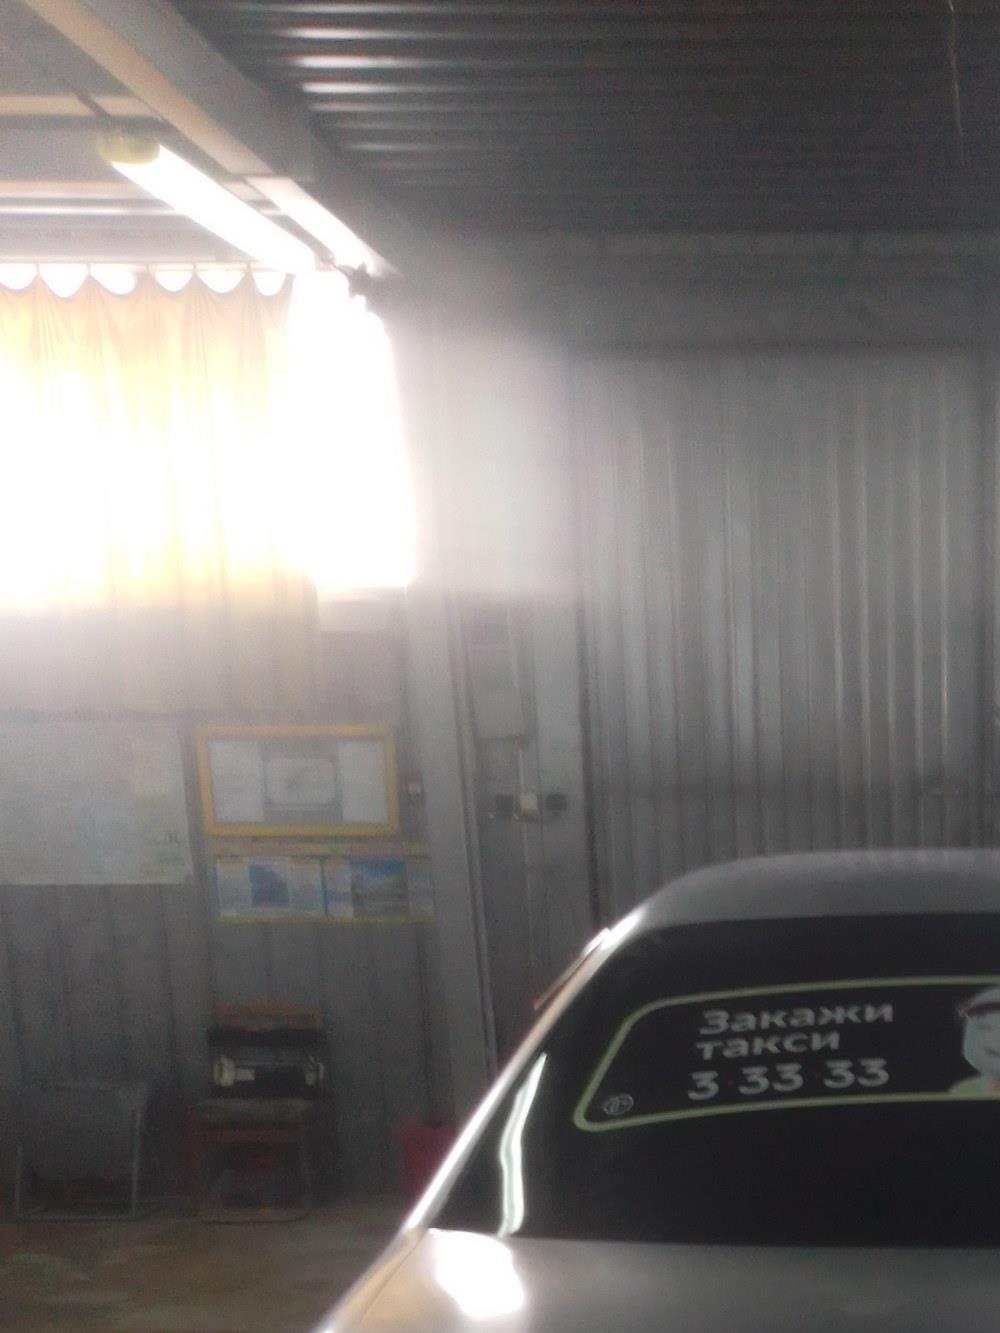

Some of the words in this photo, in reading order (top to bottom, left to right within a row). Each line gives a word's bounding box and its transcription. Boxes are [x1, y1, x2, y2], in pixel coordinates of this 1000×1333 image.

[699, 1003, 893, 1035] Закажи
[696, 1031, 840, 1060] такси
[687, 1070, 719, 1100] 3
[738, 1062, 804, 1095] 33
[823, 1057, 890, 1088] 33
